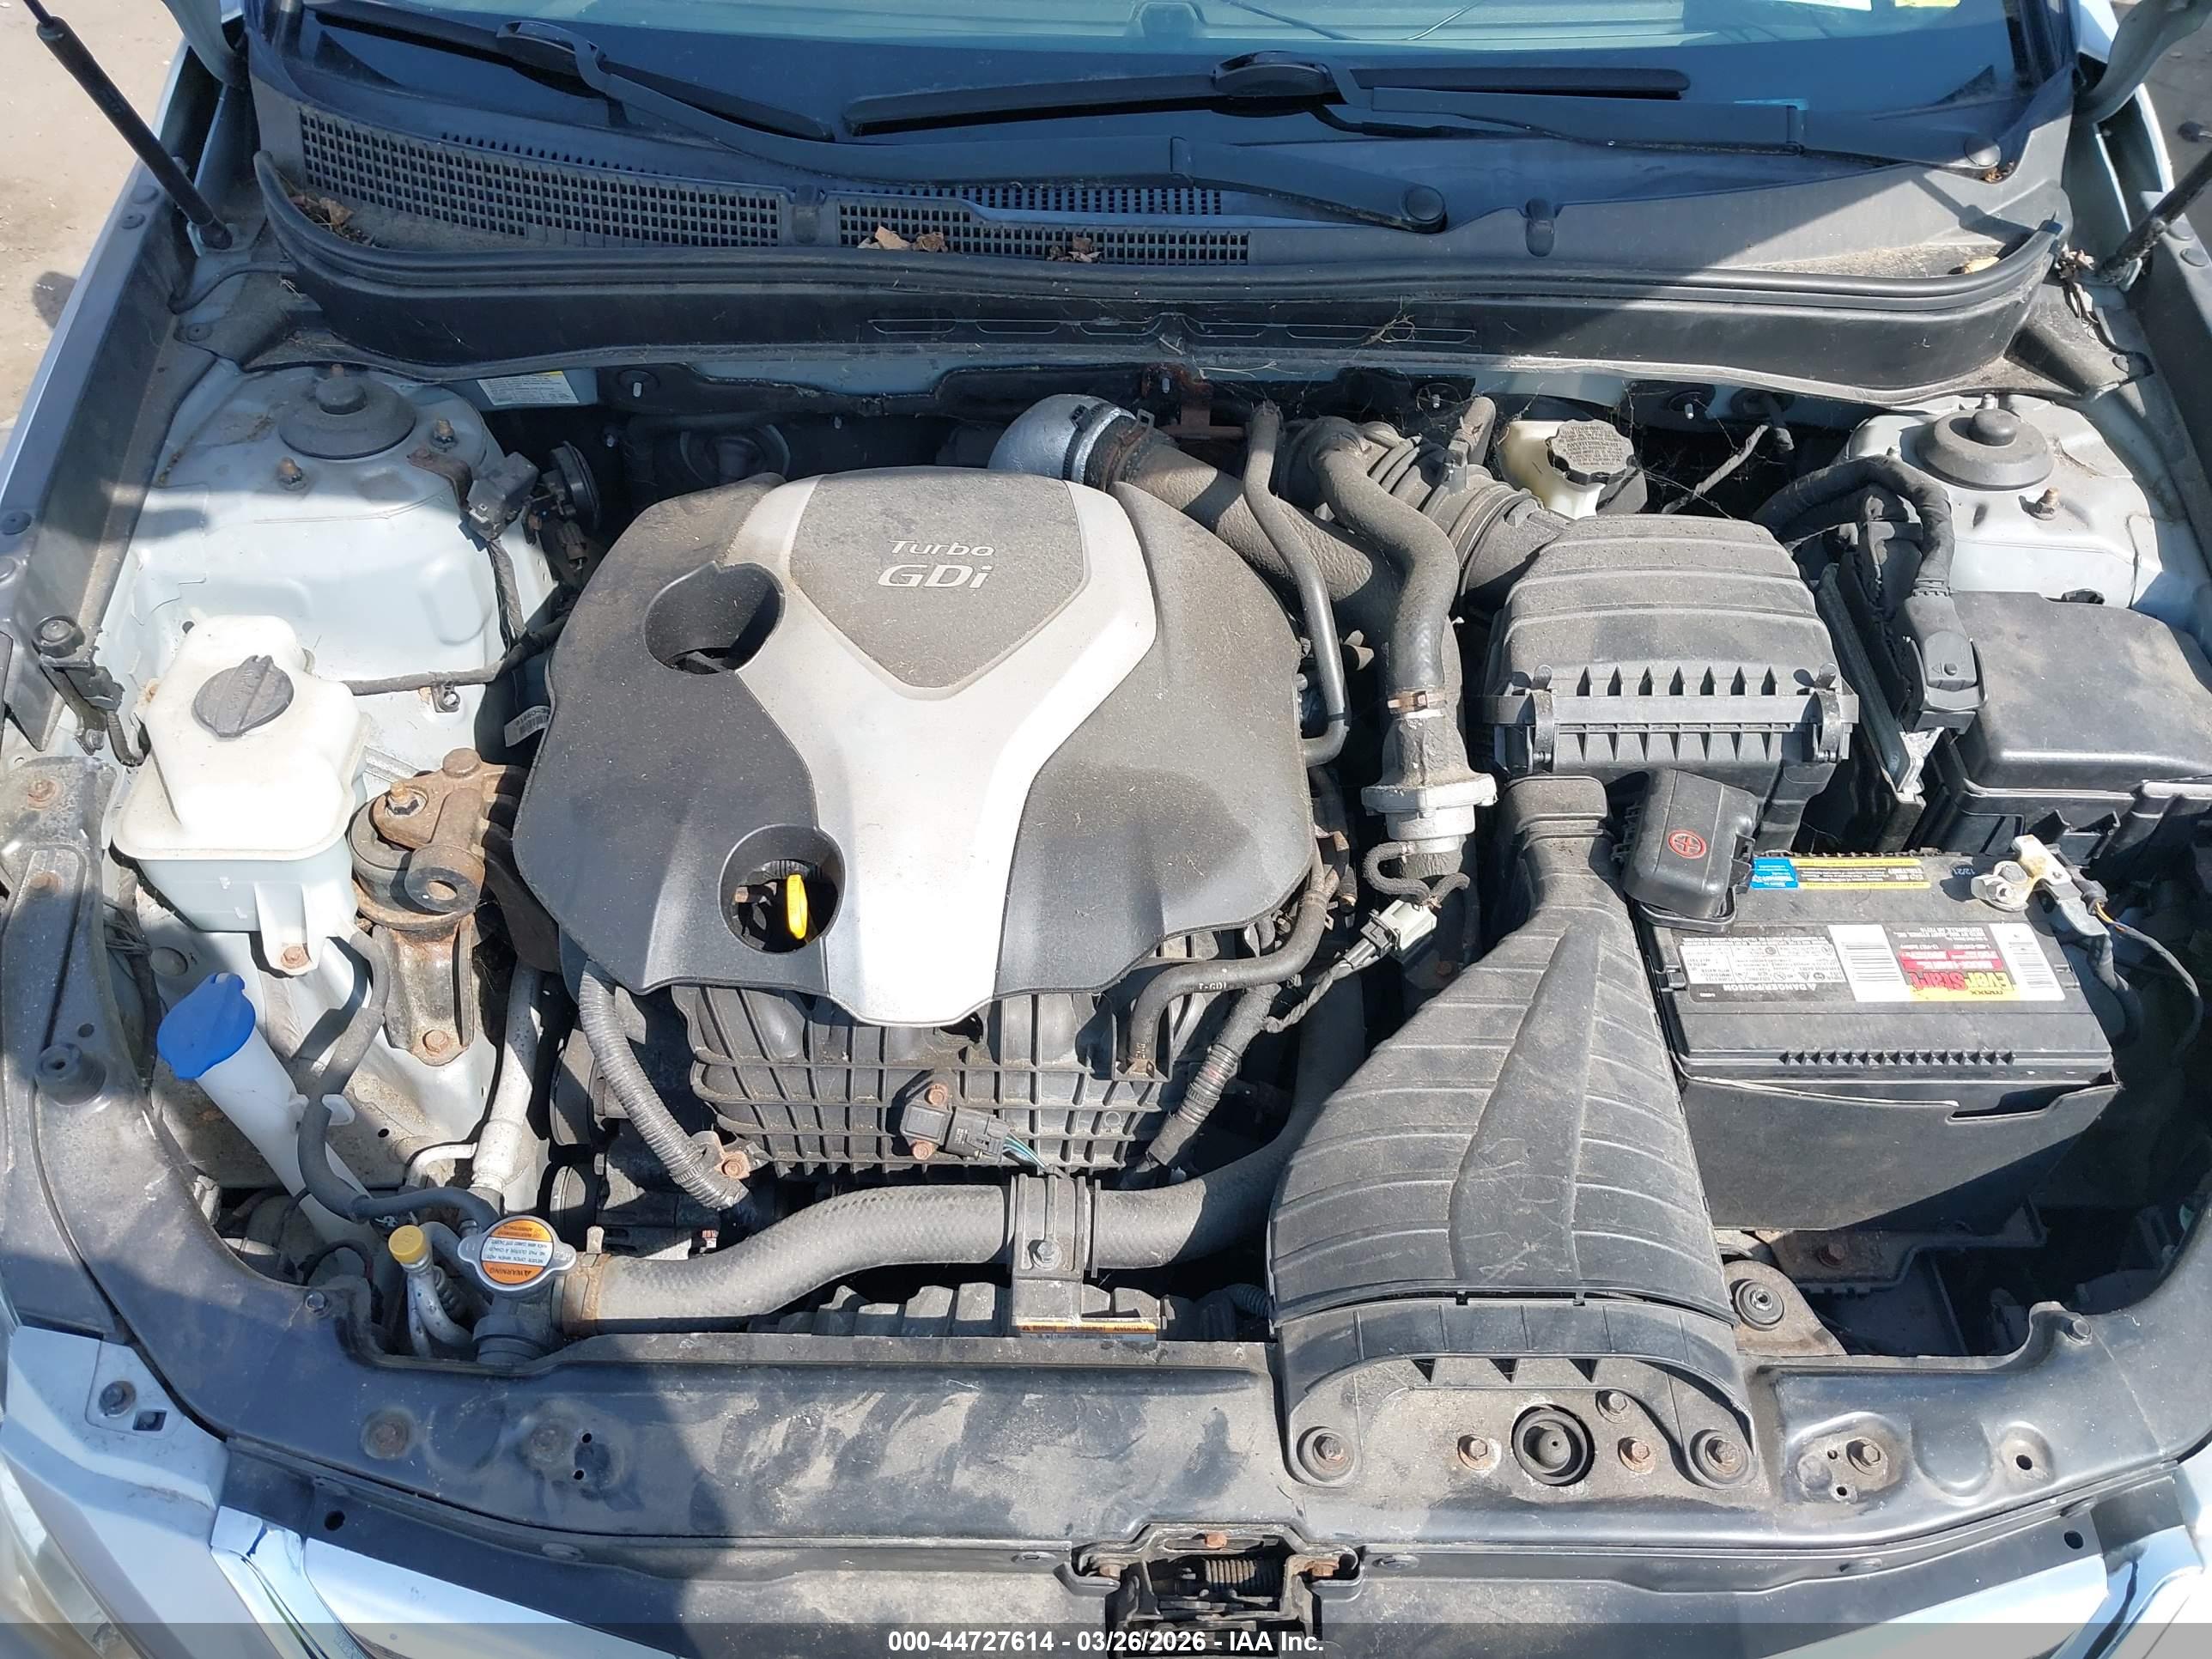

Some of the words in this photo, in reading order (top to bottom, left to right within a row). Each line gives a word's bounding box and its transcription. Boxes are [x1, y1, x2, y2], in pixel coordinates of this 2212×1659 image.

[889, 539, 996, 556] Turbo
[878, 563, 994, 589] GDi
[1908, 971, 2014, 992] EverStart
[489, 1267, 524, 1278] WARNING
